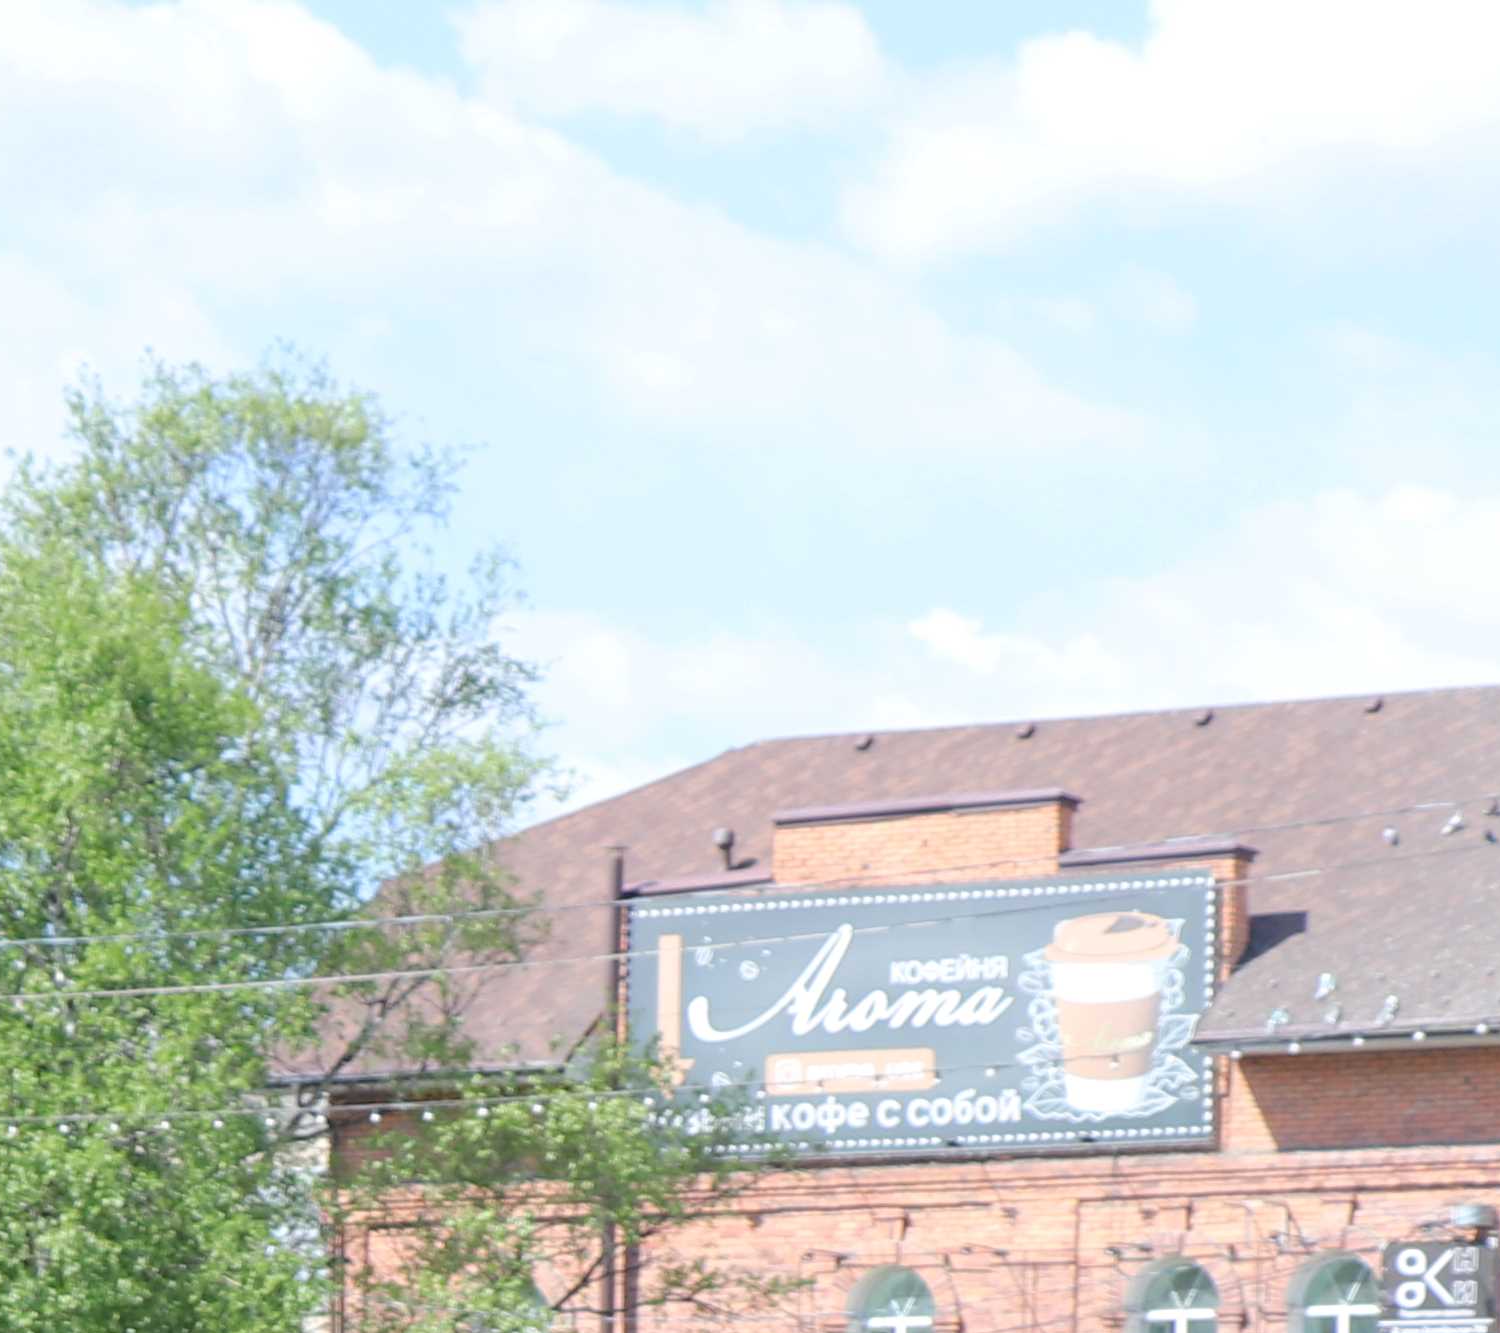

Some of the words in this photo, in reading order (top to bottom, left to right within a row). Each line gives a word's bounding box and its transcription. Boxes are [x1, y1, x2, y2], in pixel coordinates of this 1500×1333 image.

[687, 922, 1015, 1044] Aroma
[889, 953, 1009, 985] КОФЕЙНЯ
[770, 1096, 870, 1135] кофе
[876, 1101, 900, 1128] с
[906, 1087, 1022, 1129] собой
